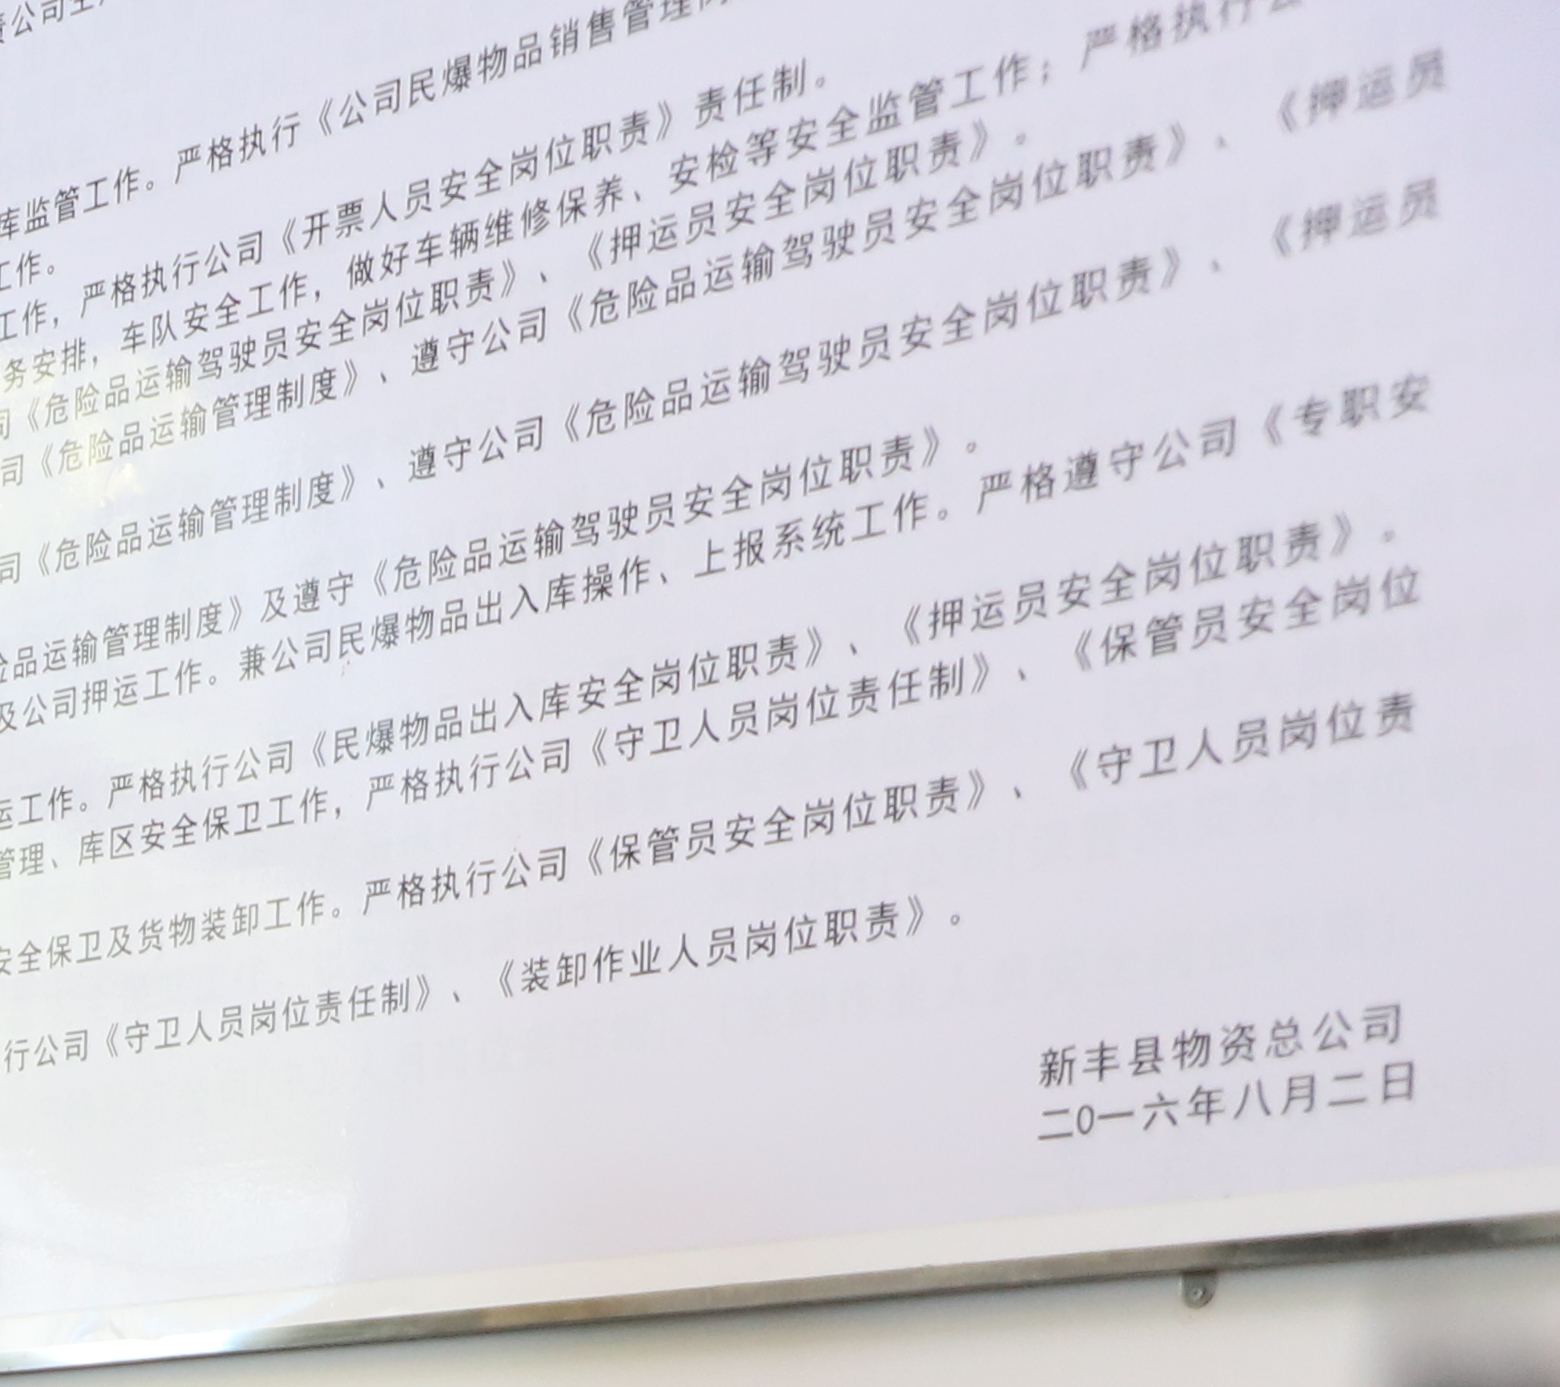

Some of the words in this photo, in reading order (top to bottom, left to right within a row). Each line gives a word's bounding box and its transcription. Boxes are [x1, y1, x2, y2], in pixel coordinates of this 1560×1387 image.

[1037, 1004, 1404, 1089] 新丰县物资总公司
